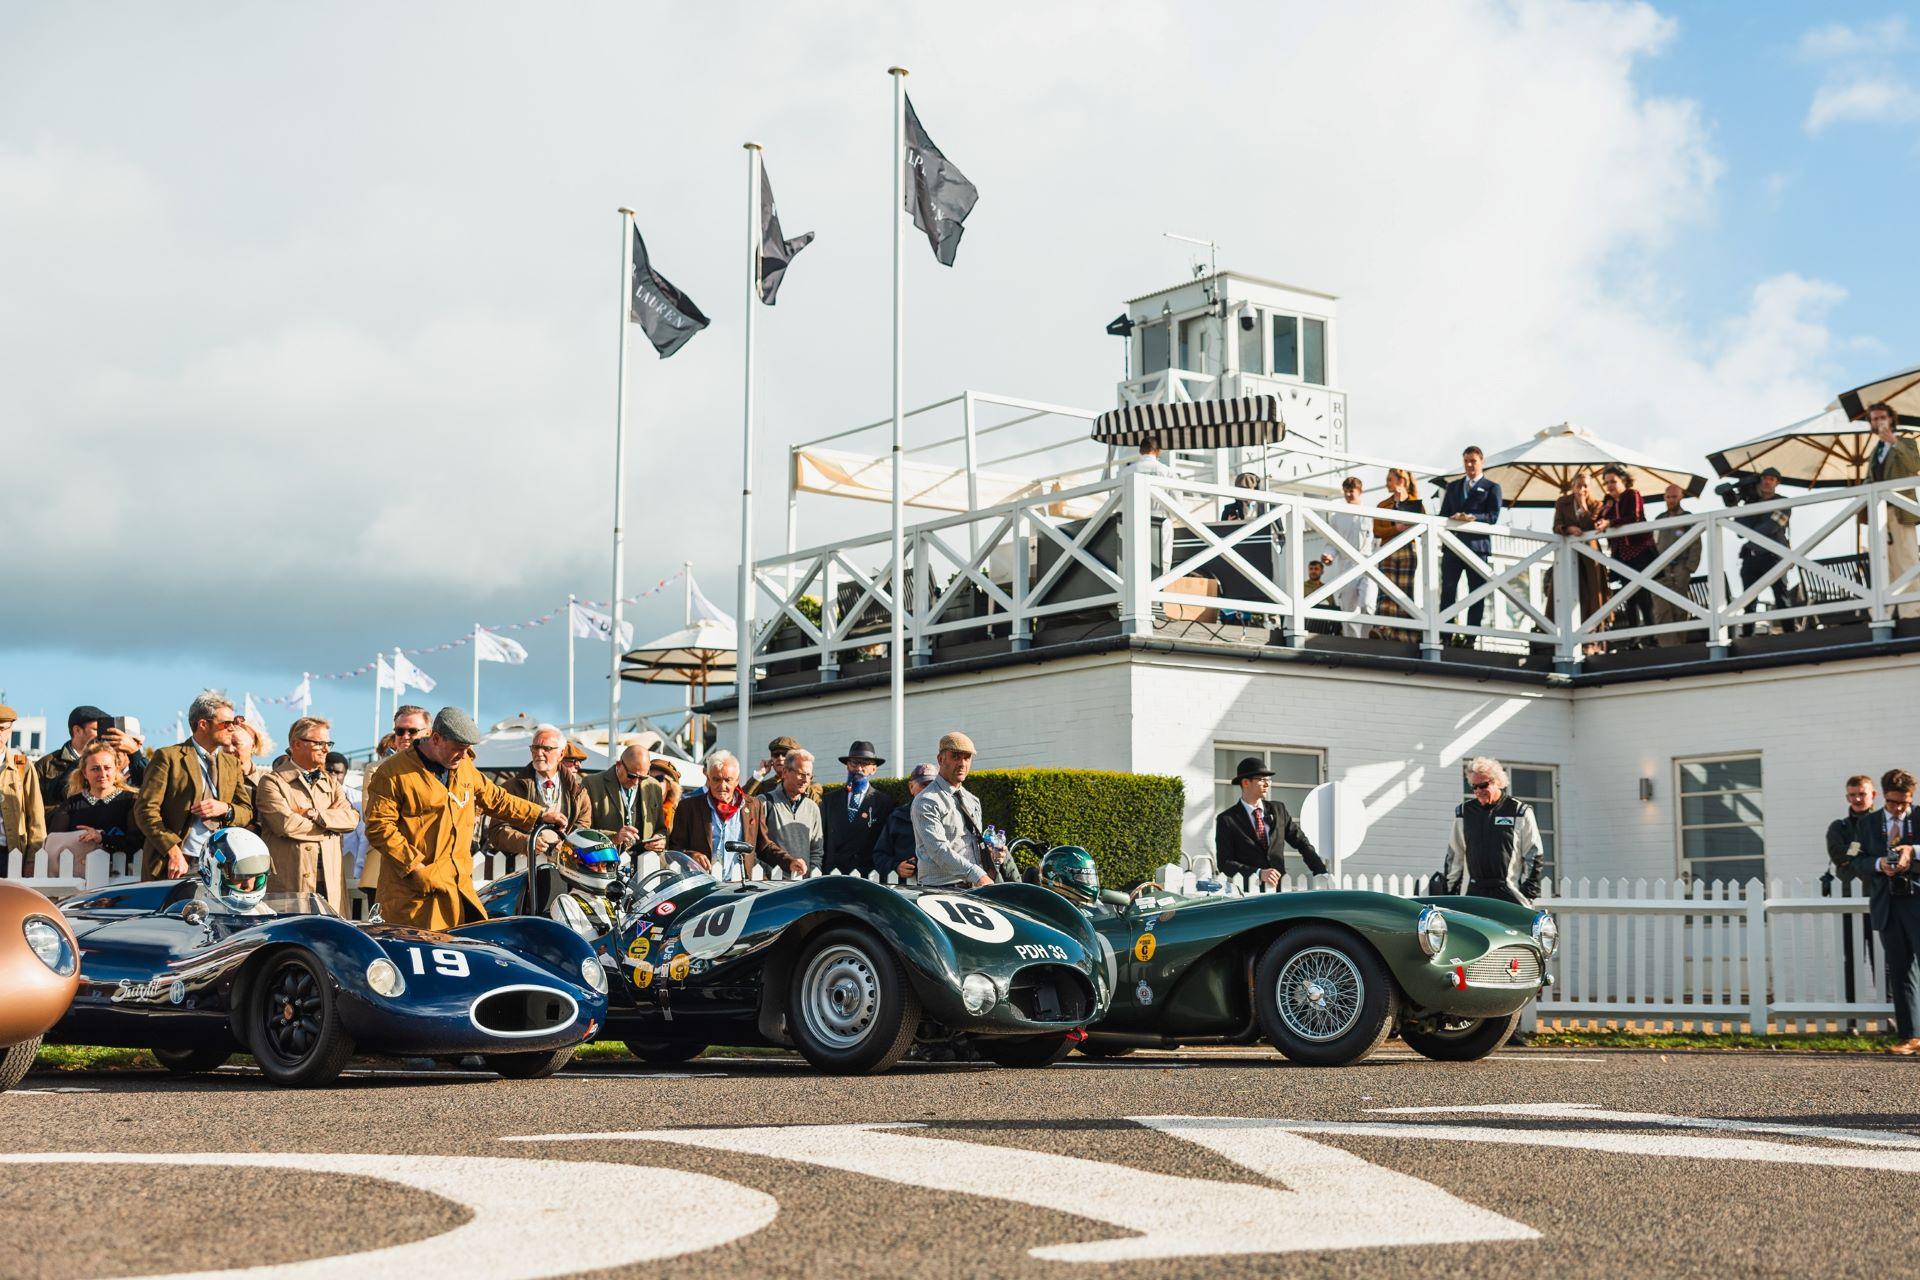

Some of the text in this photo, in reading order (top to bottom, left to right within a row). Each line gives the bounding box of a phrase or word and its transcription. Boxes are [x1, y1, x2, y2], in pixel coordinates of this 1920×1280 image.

[636, 285, 685, 328] LAUREN
[934, 900, 995, 931] 16
[664, 944, 675, 954] C
[1014, 944, 1068, 960] PDH 33
[408, 947, 471, 978] 19
[640, 970, 647, 981] C
